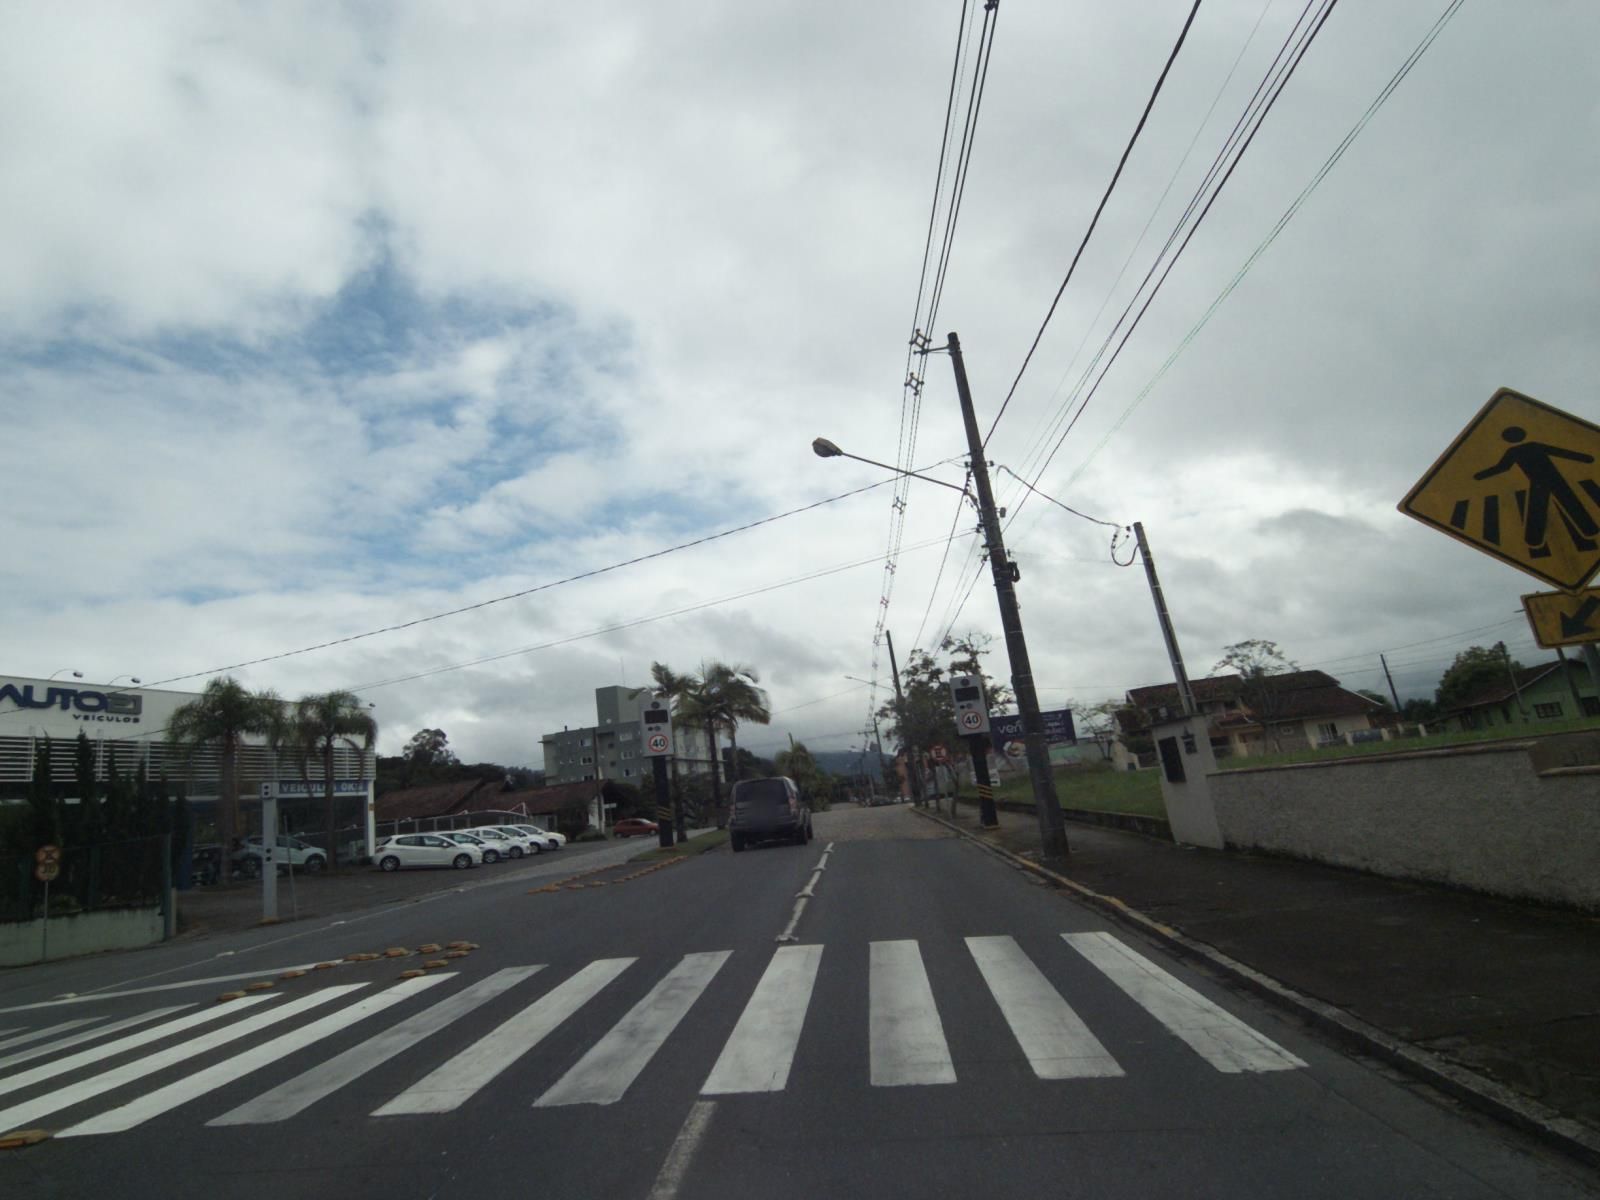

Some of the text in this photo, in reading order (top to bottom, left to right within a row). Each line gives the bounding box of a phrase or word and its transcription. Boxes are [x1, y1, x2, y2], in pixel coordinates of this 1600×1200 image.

[965, 715, 979, 724] 40
[652, 738, 666, 748] 40
[281, 783, 337, 793] VEICUL
